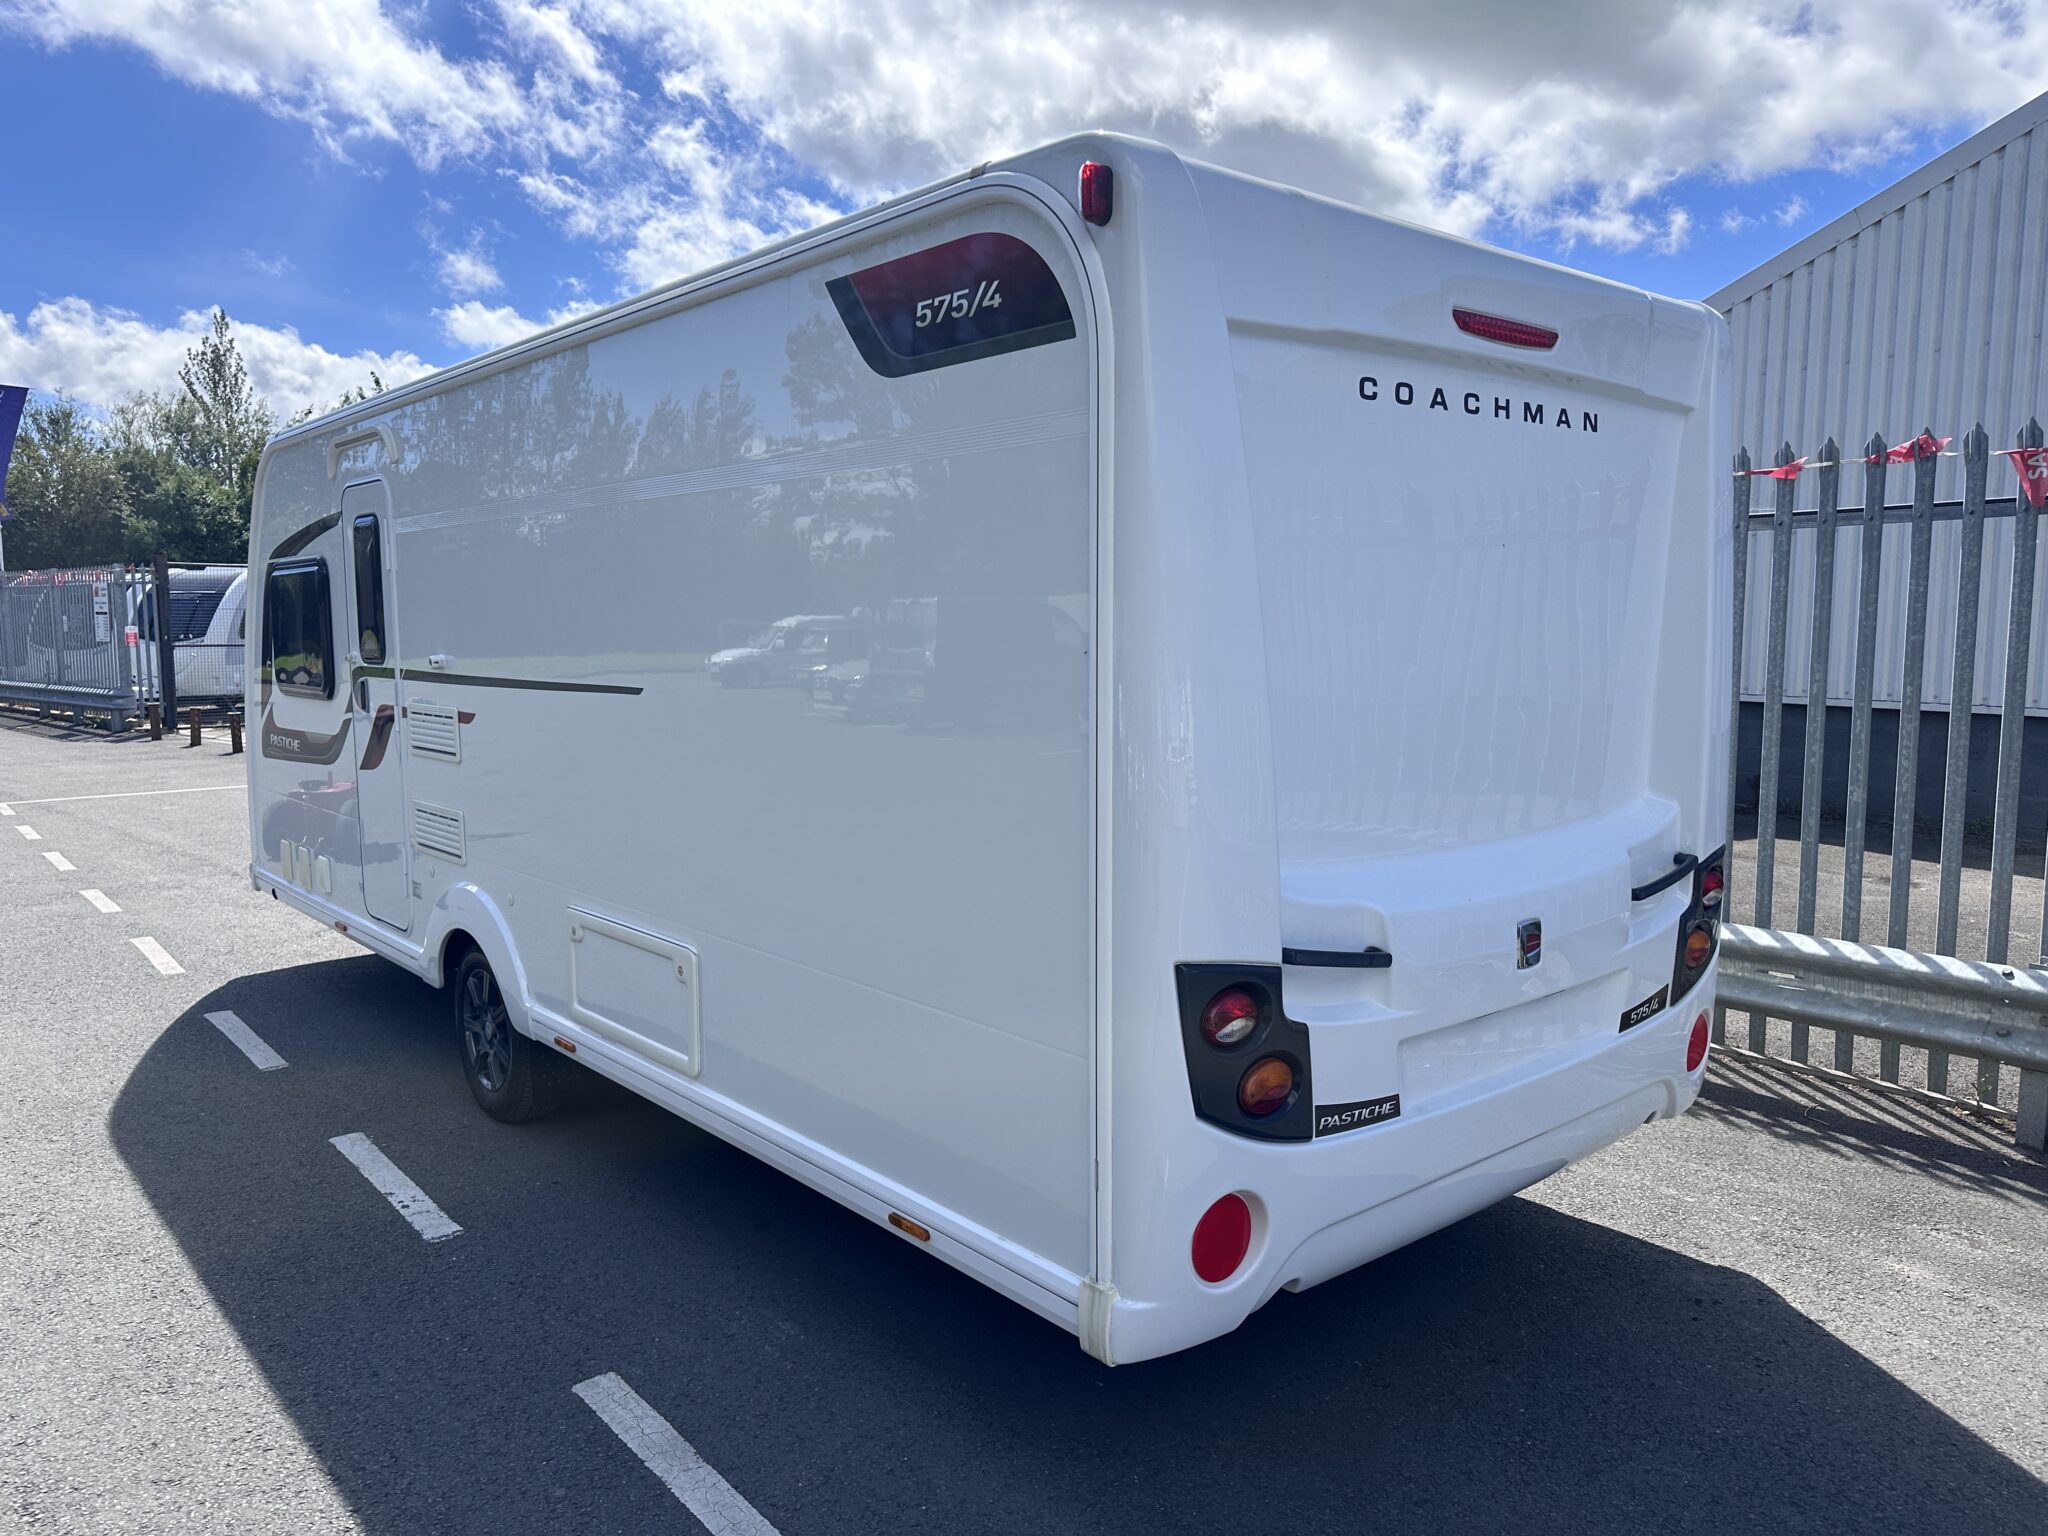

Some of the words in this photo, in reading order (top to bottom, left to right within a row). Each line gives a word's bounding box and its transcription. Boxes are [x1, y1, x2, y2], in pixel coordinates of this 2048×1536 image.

[915, 279, 1002, 328] 575/4
[1359, 376, 1598, 433] COACHMAN
[270, 734, 301, 752] PASTICHE
[1630, 998, 1659, 1024] 575/4
[1319, 1100, 1397, 1130] PASTICHE
